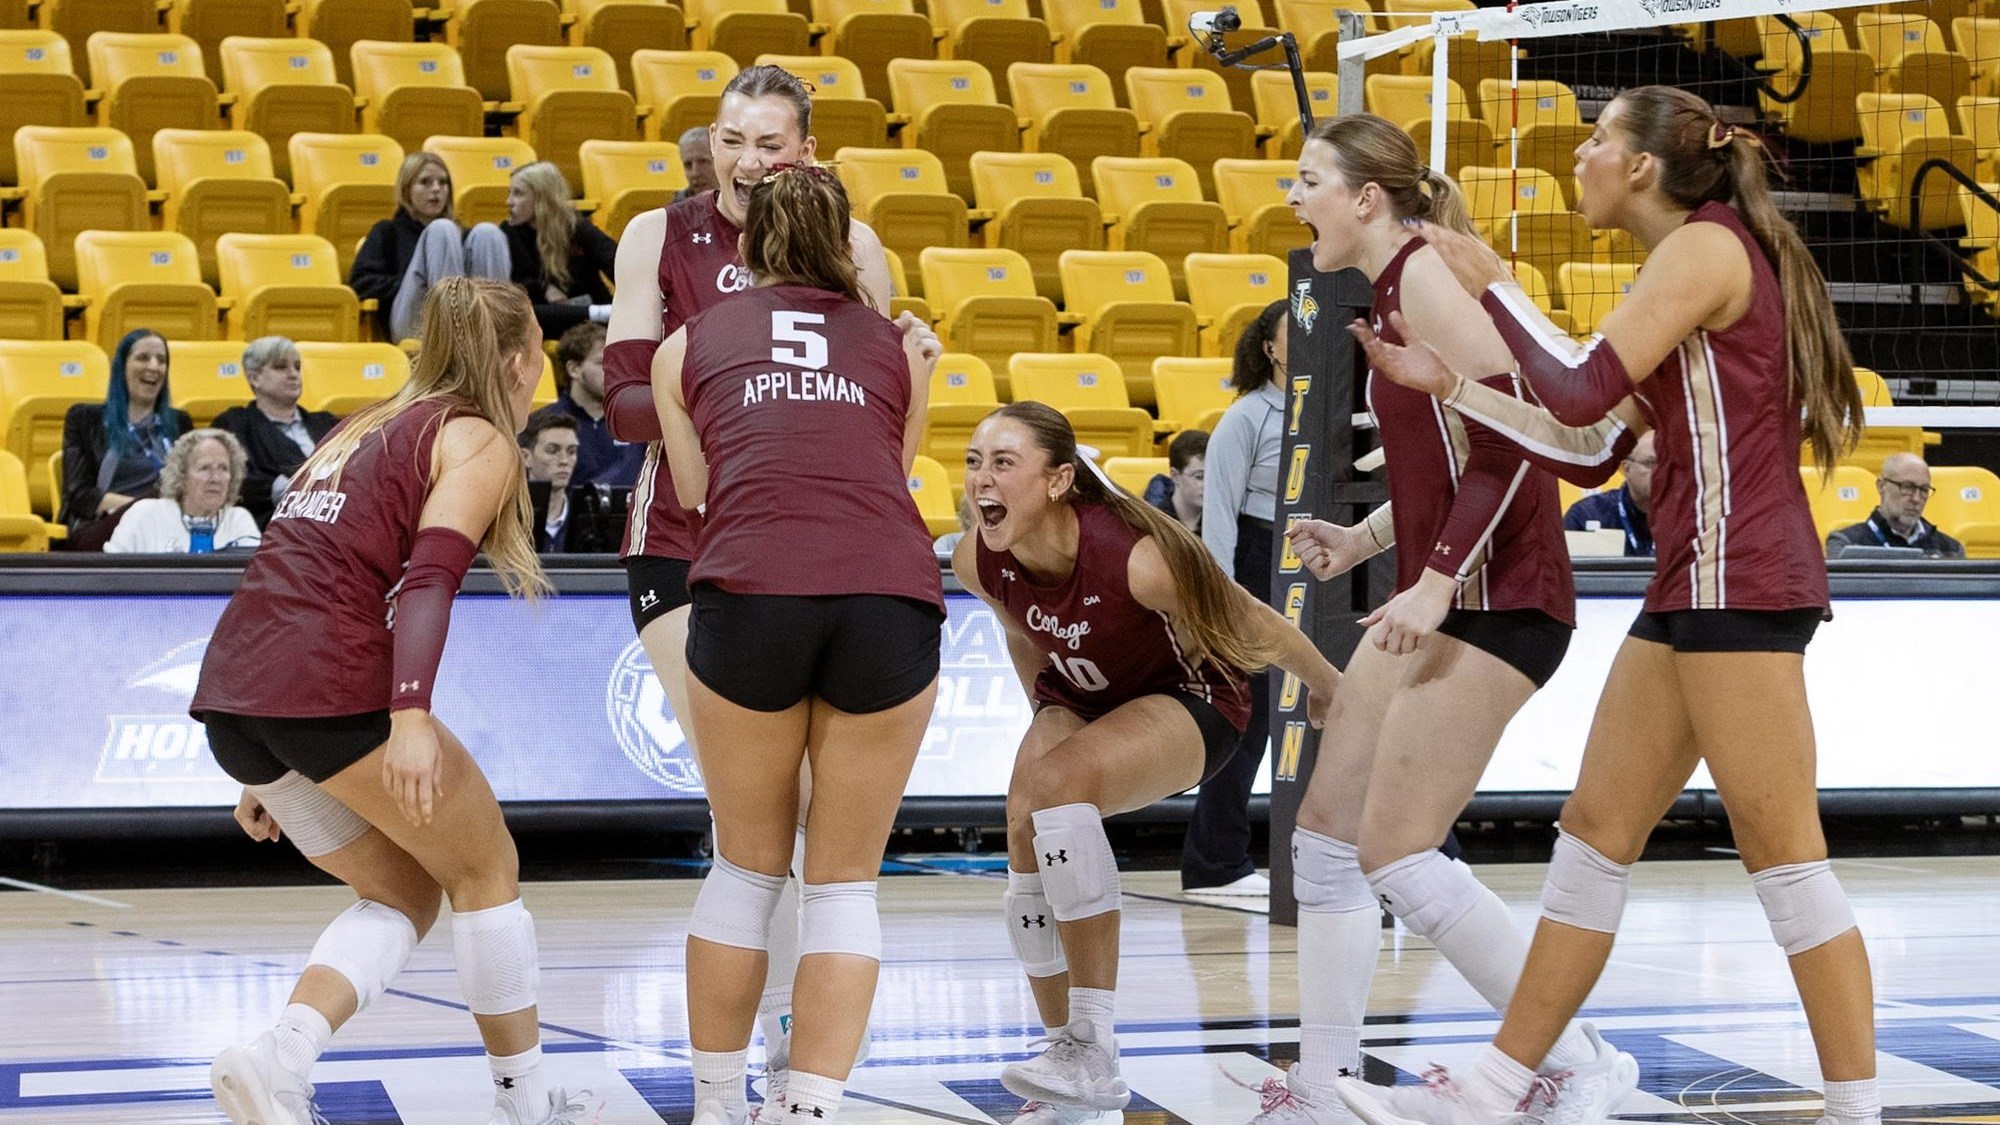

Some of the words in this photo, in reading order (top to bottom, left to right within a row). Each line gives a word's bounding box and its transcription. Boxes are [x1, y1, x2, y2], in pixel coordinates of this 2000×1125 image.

[772, 311, 828, 370] 5
[743, 371, 865, 407] APPLEMAN
[1048, 651, 1110, 692] 10
